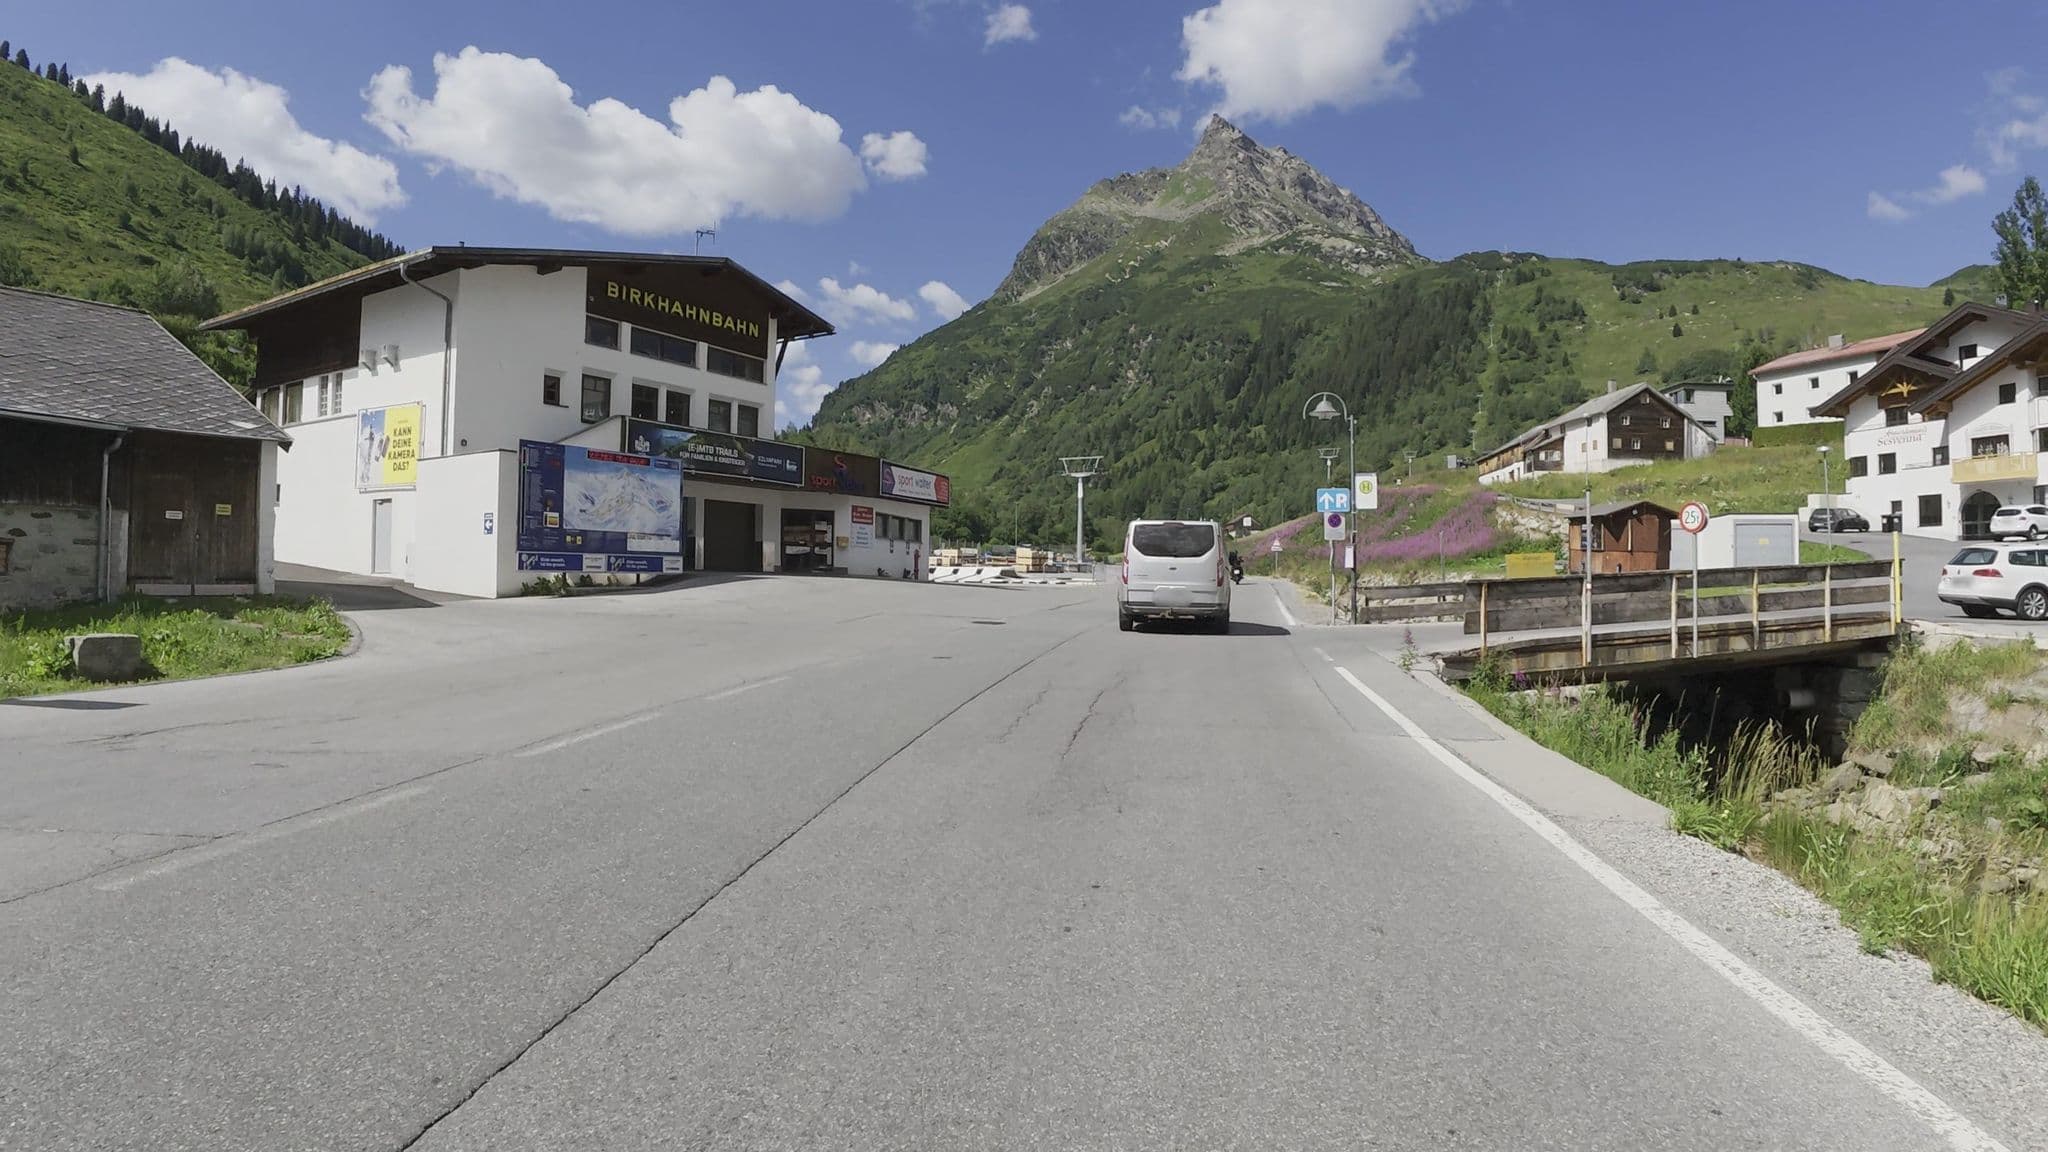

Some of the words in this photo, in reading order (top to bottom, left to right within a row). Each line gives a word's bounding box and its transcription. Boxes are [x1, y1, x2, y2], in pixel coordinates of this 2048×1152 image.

[607, 281, 759, 338] BIRKHAHNBAHN
[393, 426, 412, 437] KANN
[392, 438, 412, 449] DEINE
[388, 449, 415, 461] KAMERA
[715, 446, 739, 458] TRAILS
[392, 461, 410, 472] DAS?
[898, 474, 913, 489] sport
